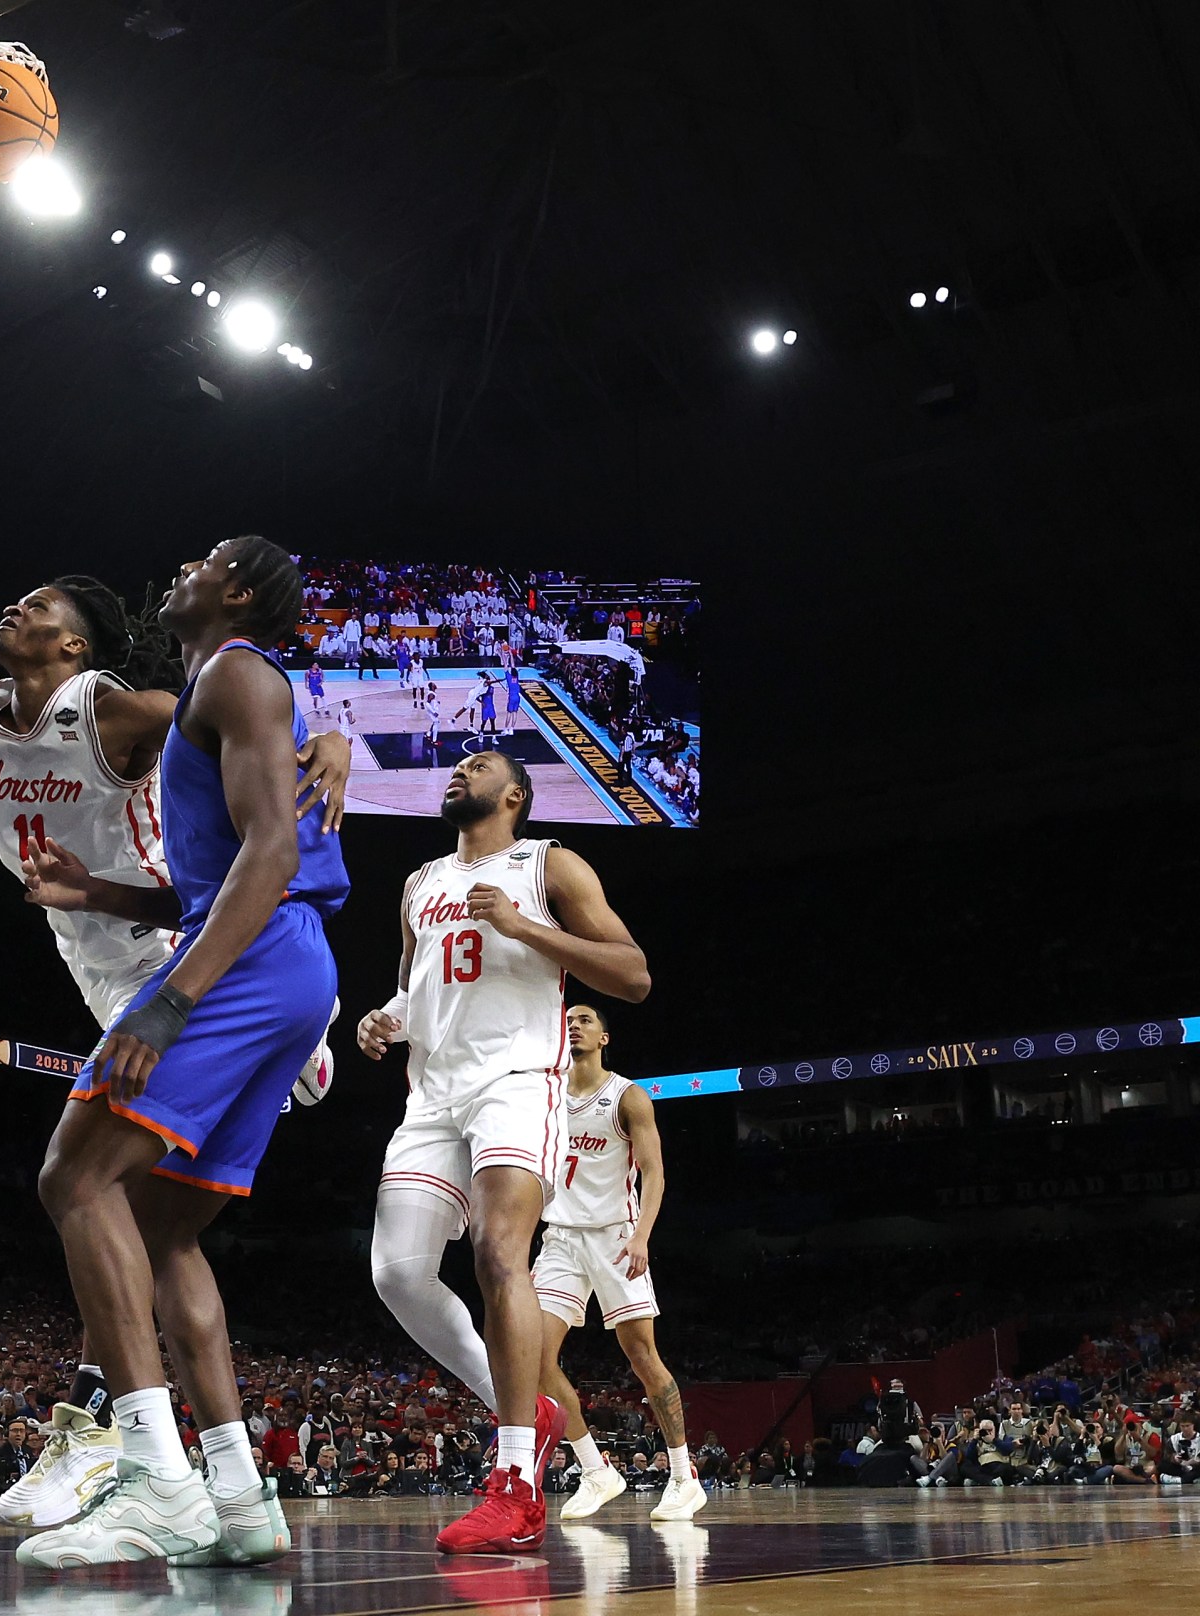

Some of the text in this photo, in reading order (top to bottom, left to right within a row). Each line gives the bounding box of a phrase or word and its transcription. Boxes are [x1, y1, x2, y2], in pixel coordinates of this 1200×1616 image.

[518, 682, 558, 708] NCAA
[543, 709, 591, 745] MEN'S
[575, 745, 619, 784] FINAL
[611, 785, 663, 824] FOUR
[13, 813, 47, 862] 11
[441, 929, 483, 985] 13
[35, 1053, 68, 1072] 2025
[908, 1042, 998, 1071] 20 SATX 25
[568, 1131, 608, 1152] ston
[565, 1155, 579, 1190] 7
[935, 1185, 1000, 1205] THE
[1016, 1176, 1105, 1200] ROAD
[830, 1422, 866, 1441] FINA
